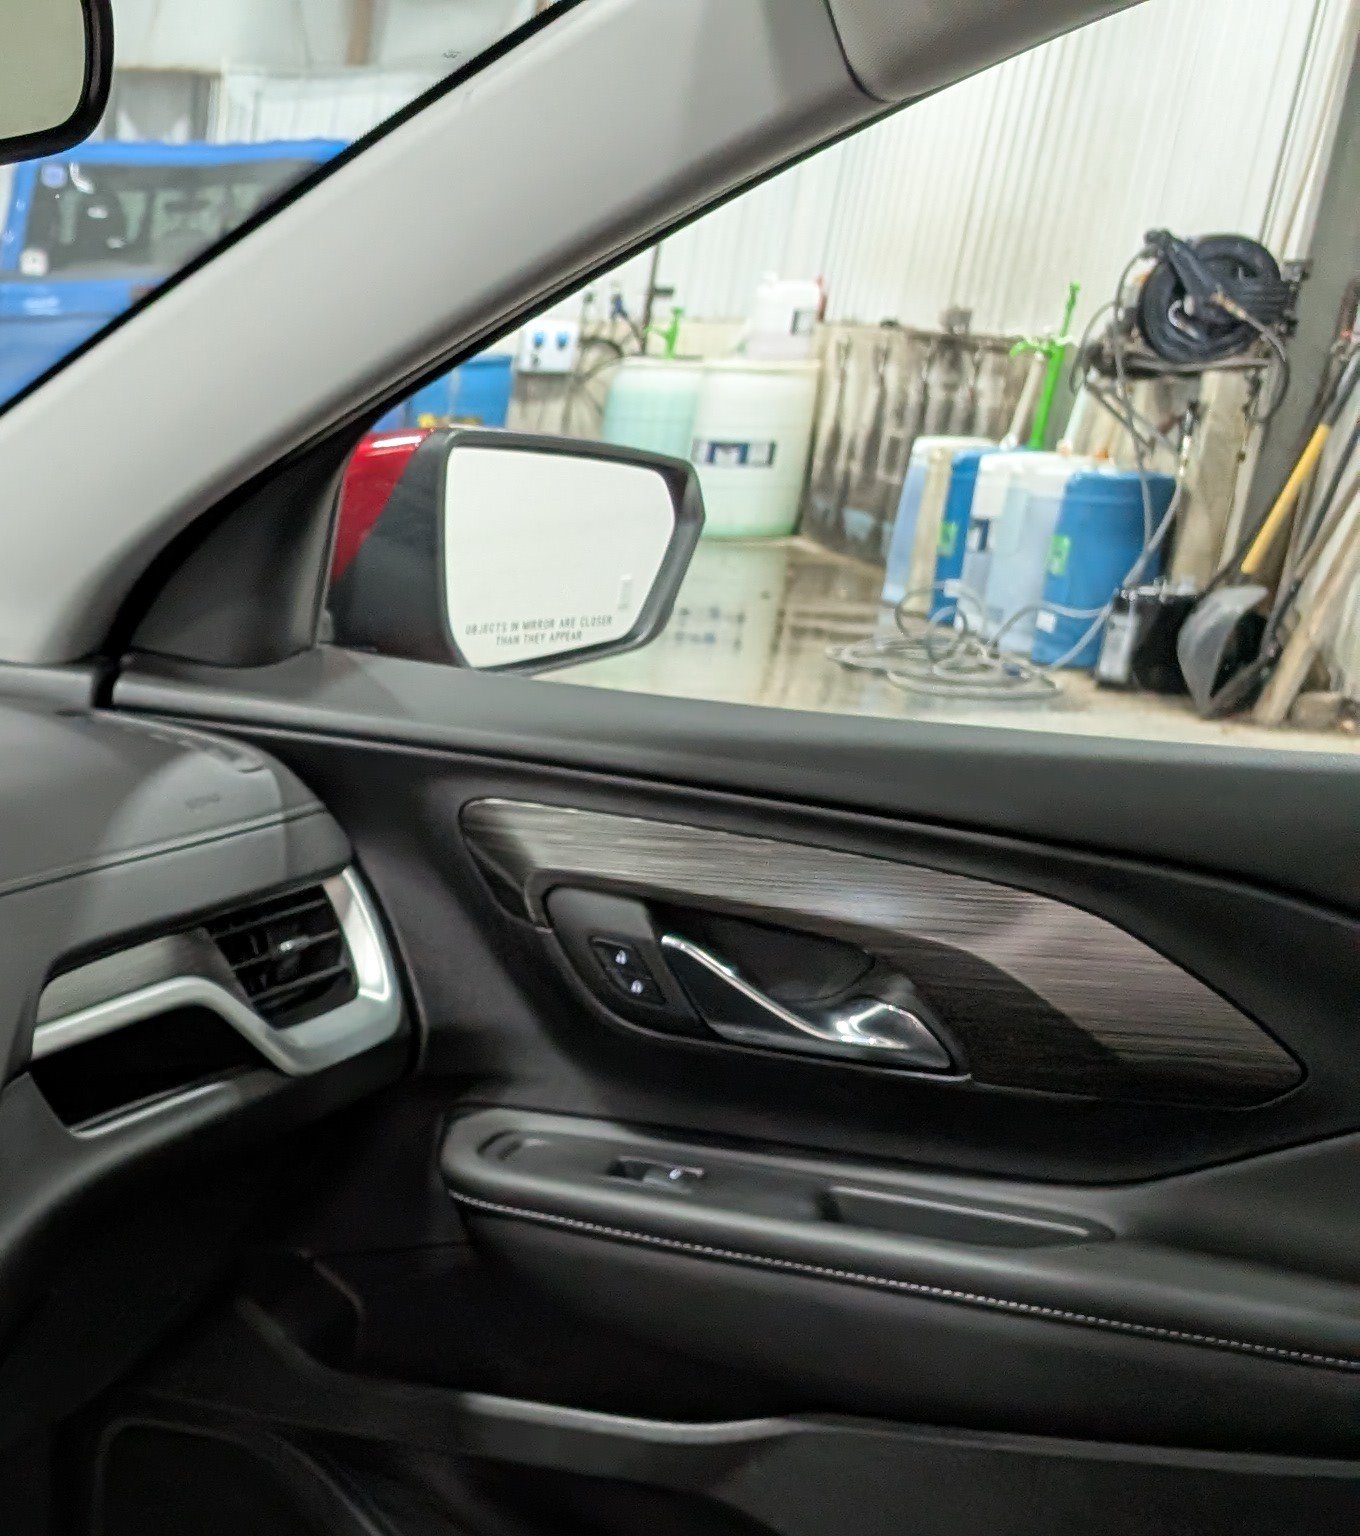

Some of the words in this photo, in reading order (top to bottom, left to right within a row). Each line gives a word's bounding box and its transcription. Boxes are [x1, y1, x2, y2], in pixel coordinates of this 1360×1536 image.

[522, 618, 555, 631] MIRROR
[559, 616, 576, 629] ARE
[580, 614, 613, 628] CLOSER
[496, 634, 519, 646] THAN
[523, 633, 545, 645] THEY
[549, 630, 583, 642] APPEAR
